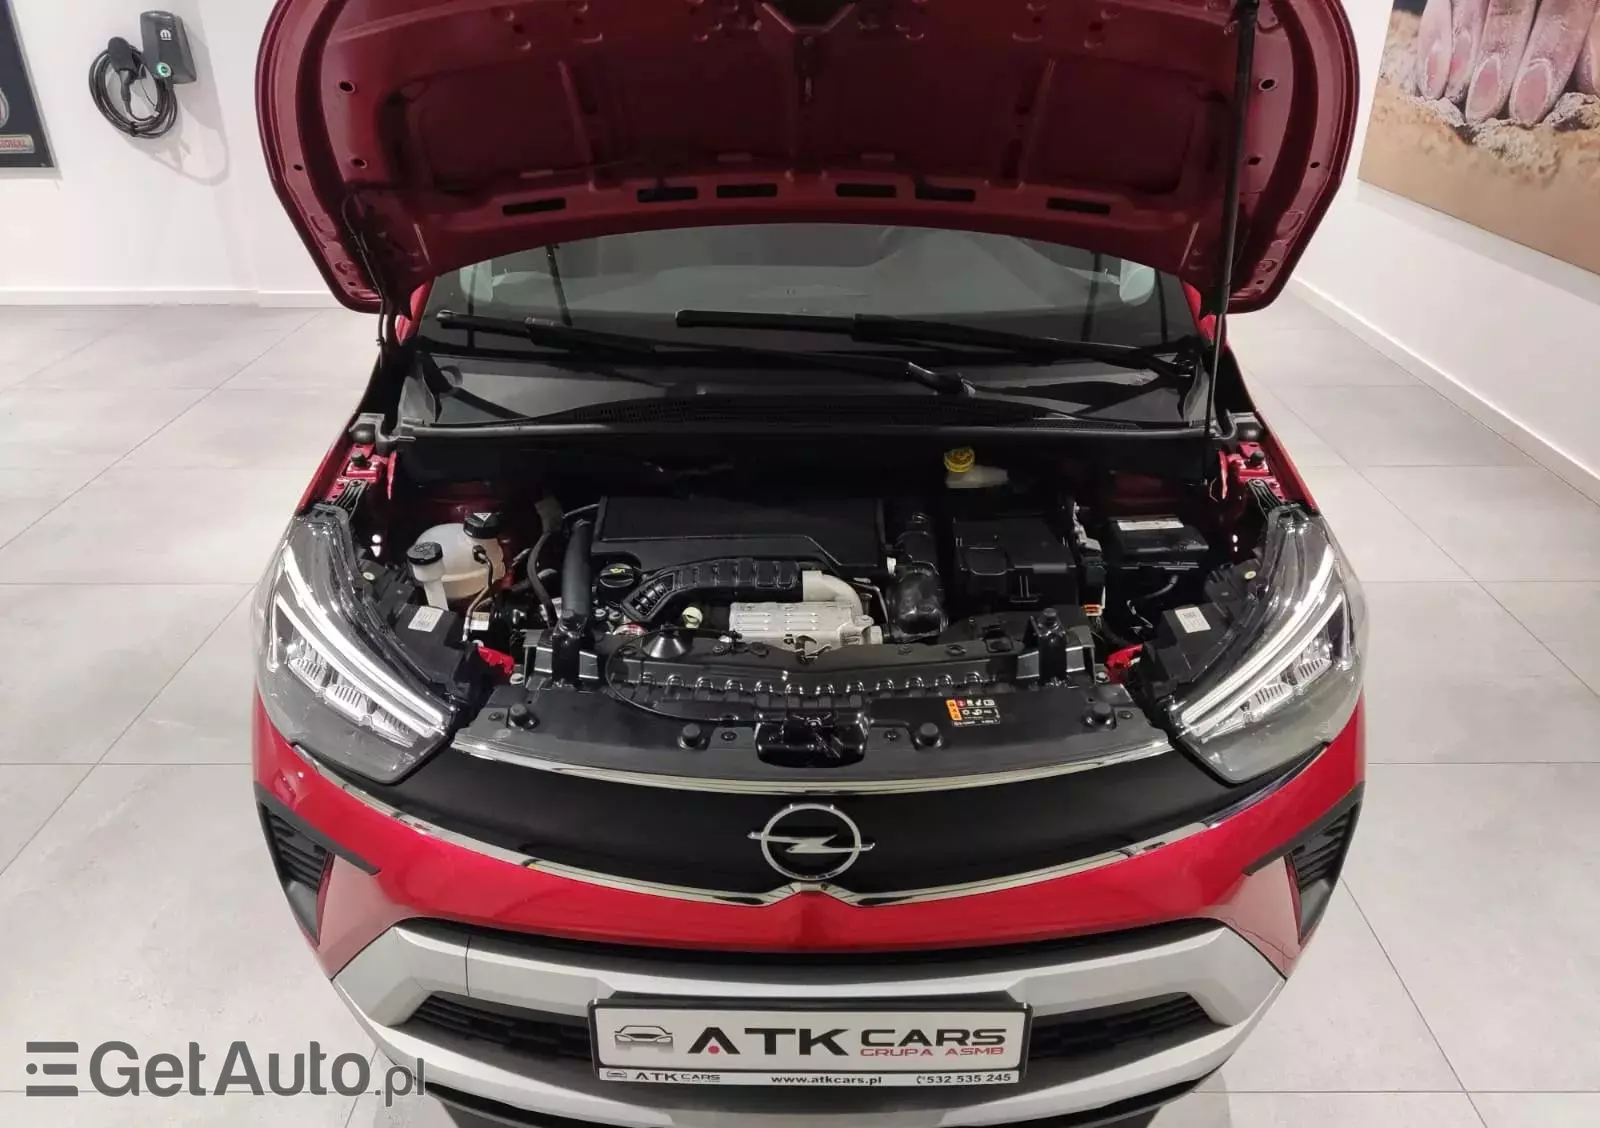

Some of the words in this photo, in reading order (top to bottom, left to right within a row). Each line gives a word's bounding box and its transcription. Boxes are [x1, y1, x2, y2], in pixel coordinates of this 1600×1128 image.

[688, 1027, 849, 1056] ATK
[861, 1029, 1007, 1046] CARS
[860, 1048, 933, 1057] GRUPA
[945, 1047, 1004, 1056] ASMB
[636, 1072, 679, 1081] ATK
[771, 1076, 882, 1085] www.atkcars.pl
[927, 1075, 951, 1084] 532
[957, 1074, 982, 1083] 535
[986, 1073, 1011, 1083] 245
